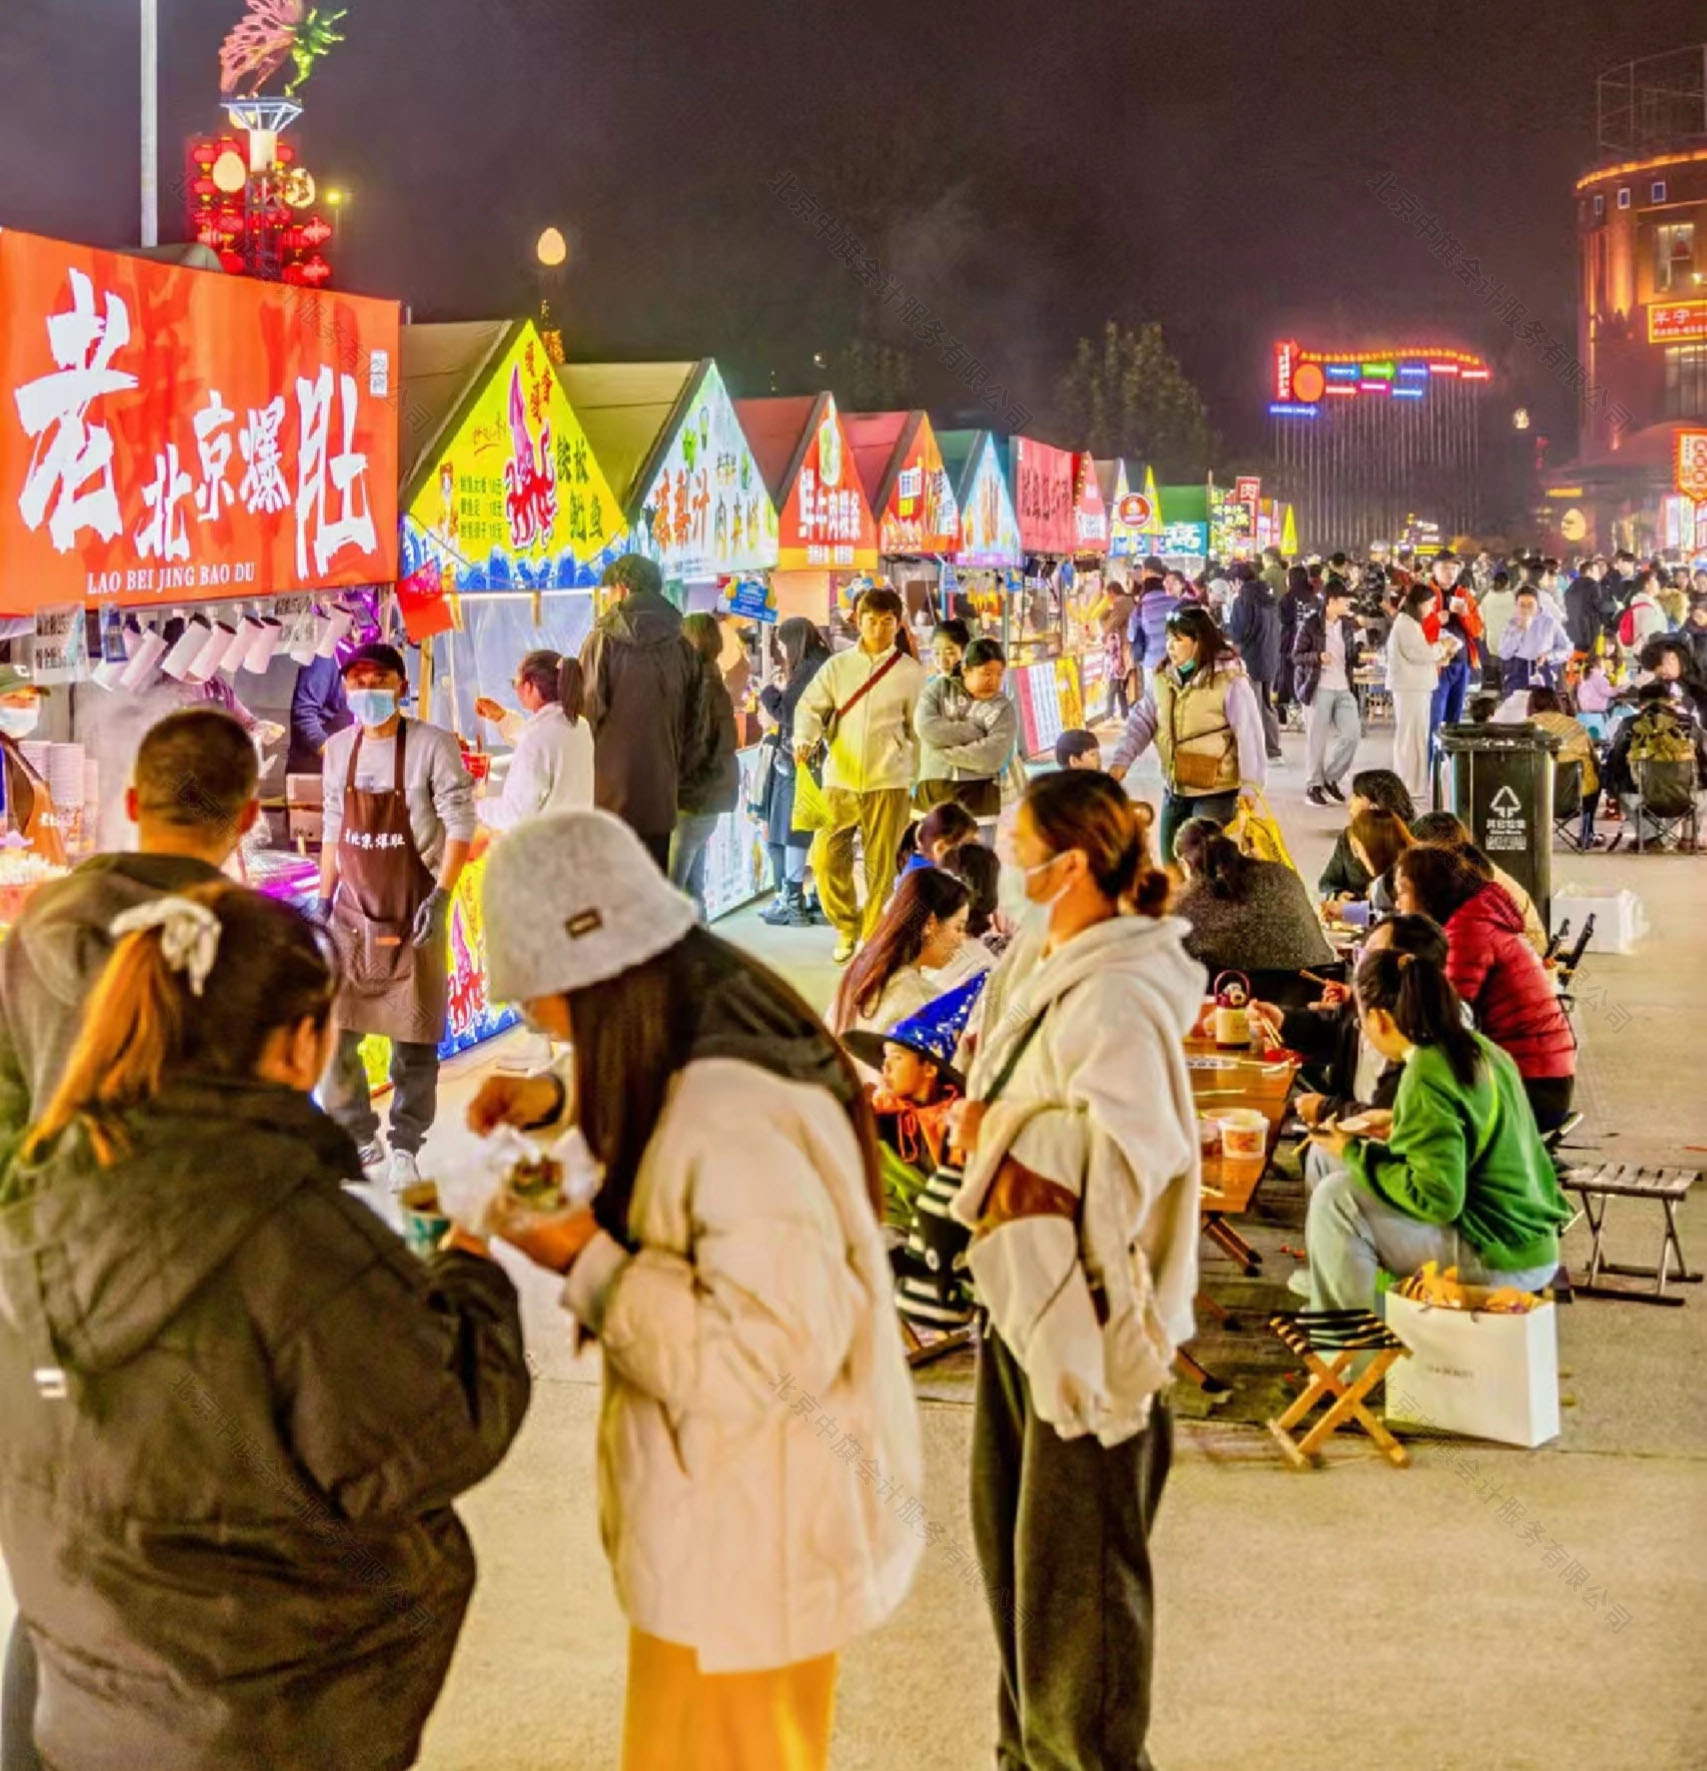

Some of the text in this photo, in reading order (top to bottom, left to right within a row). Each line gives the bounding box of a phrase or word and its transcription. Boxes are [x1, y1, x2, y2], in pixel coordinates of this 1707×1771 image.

[14, 268, 377, 580] 老北京爆肚
[88, 562, 255, 594] LAO BEI JING BAO DU
